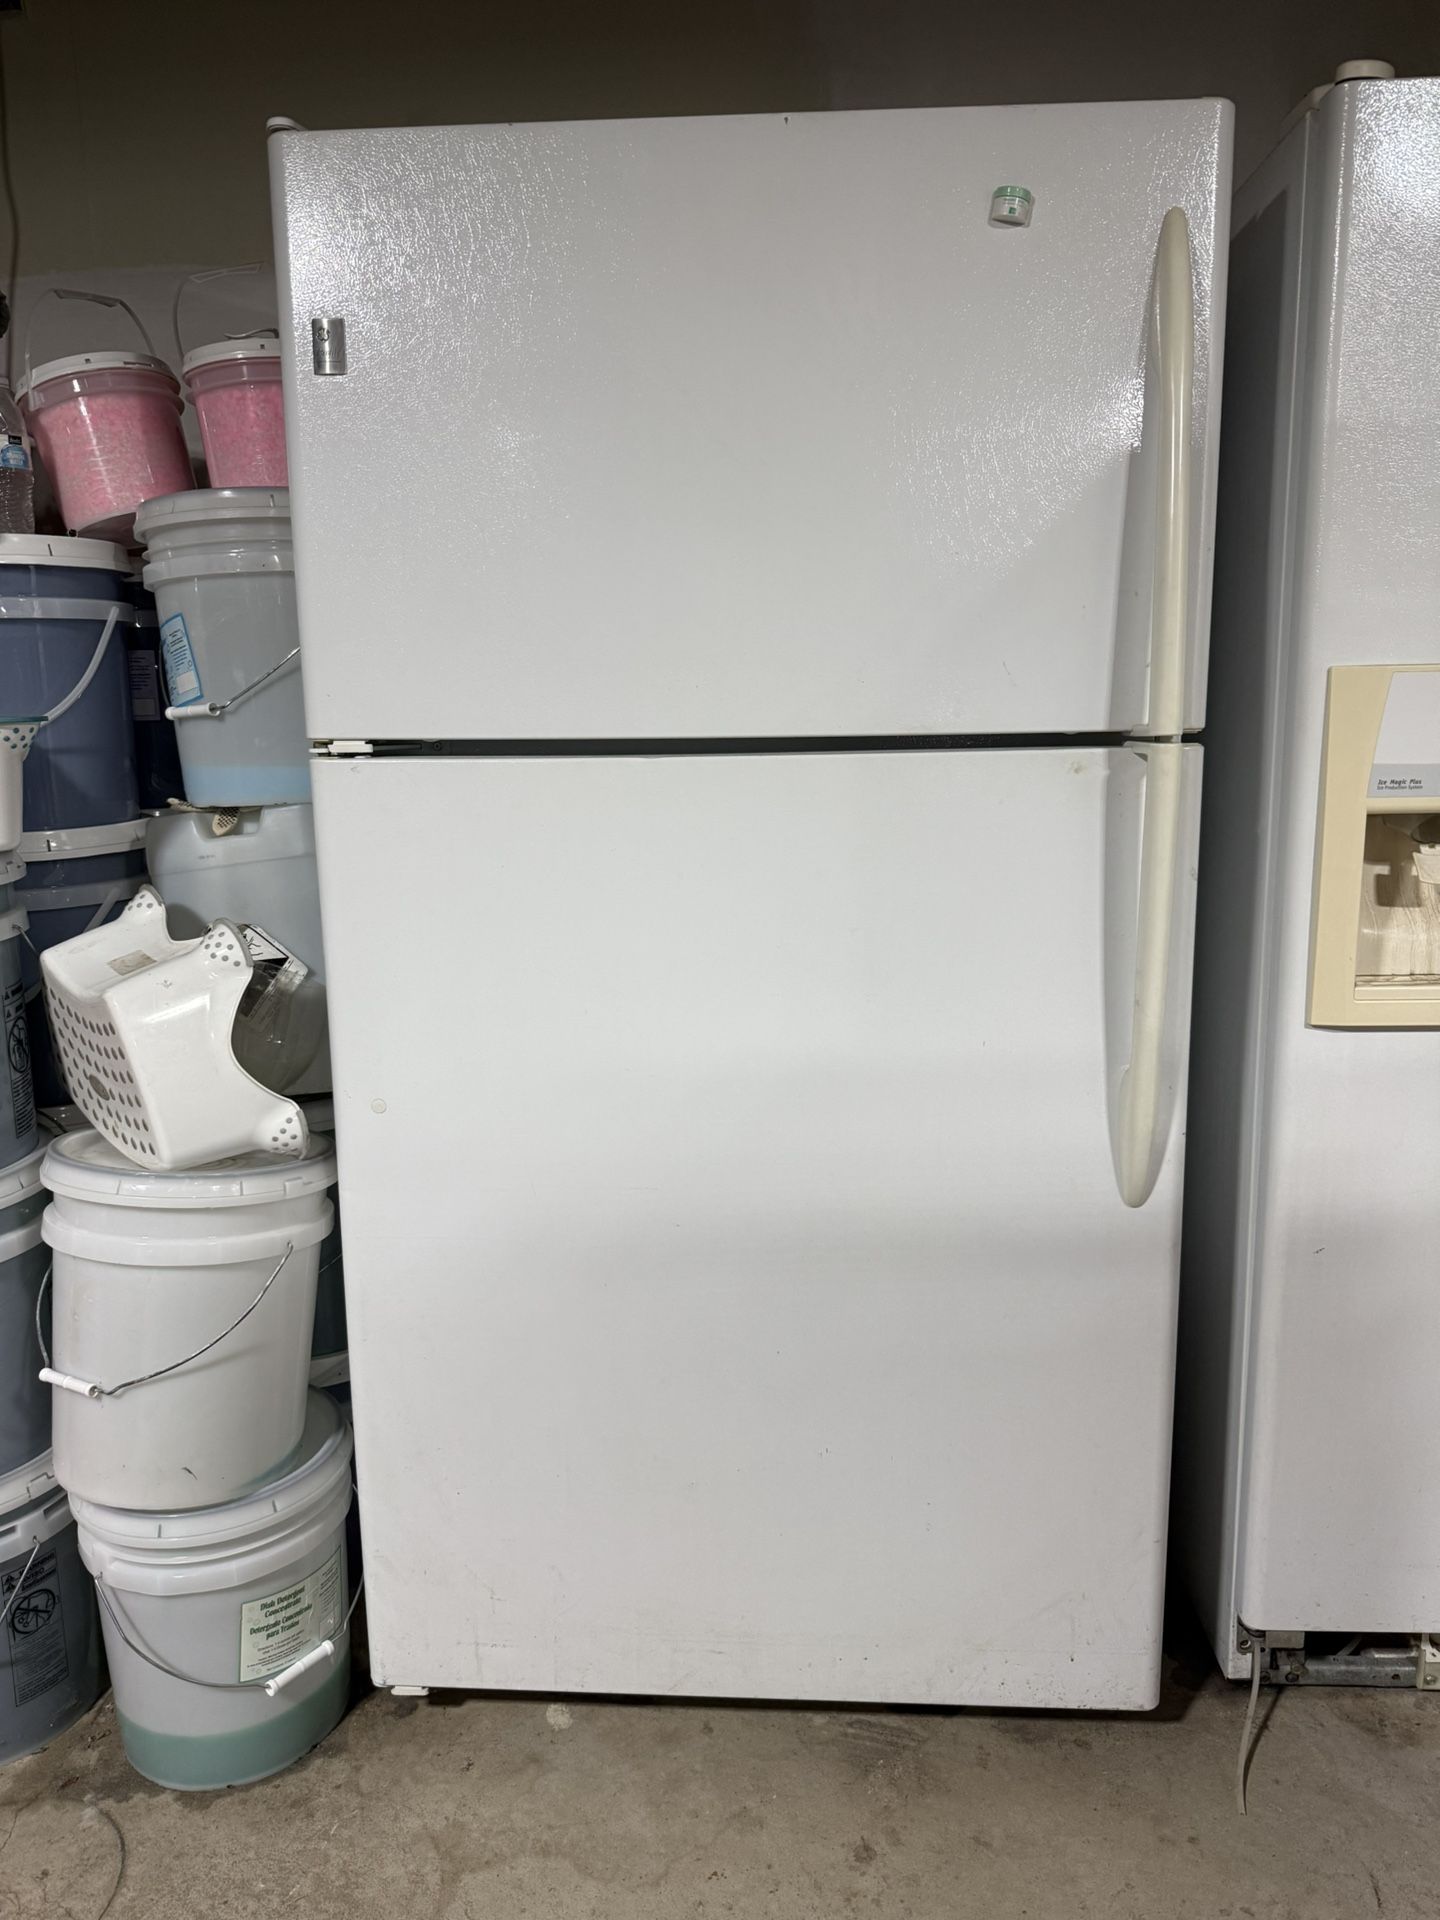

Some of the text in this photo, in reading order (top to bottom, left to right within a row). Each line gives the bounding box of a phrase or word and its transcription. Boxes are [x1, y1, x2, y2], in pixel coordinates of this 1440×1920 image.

[1389, 778, 1407, 786] Magic
[260, 1585, 305, 1611] Dish Detergent
[264, 1597, 301, 1618] Concentrate
[266, 1629, 280, 1640] para
